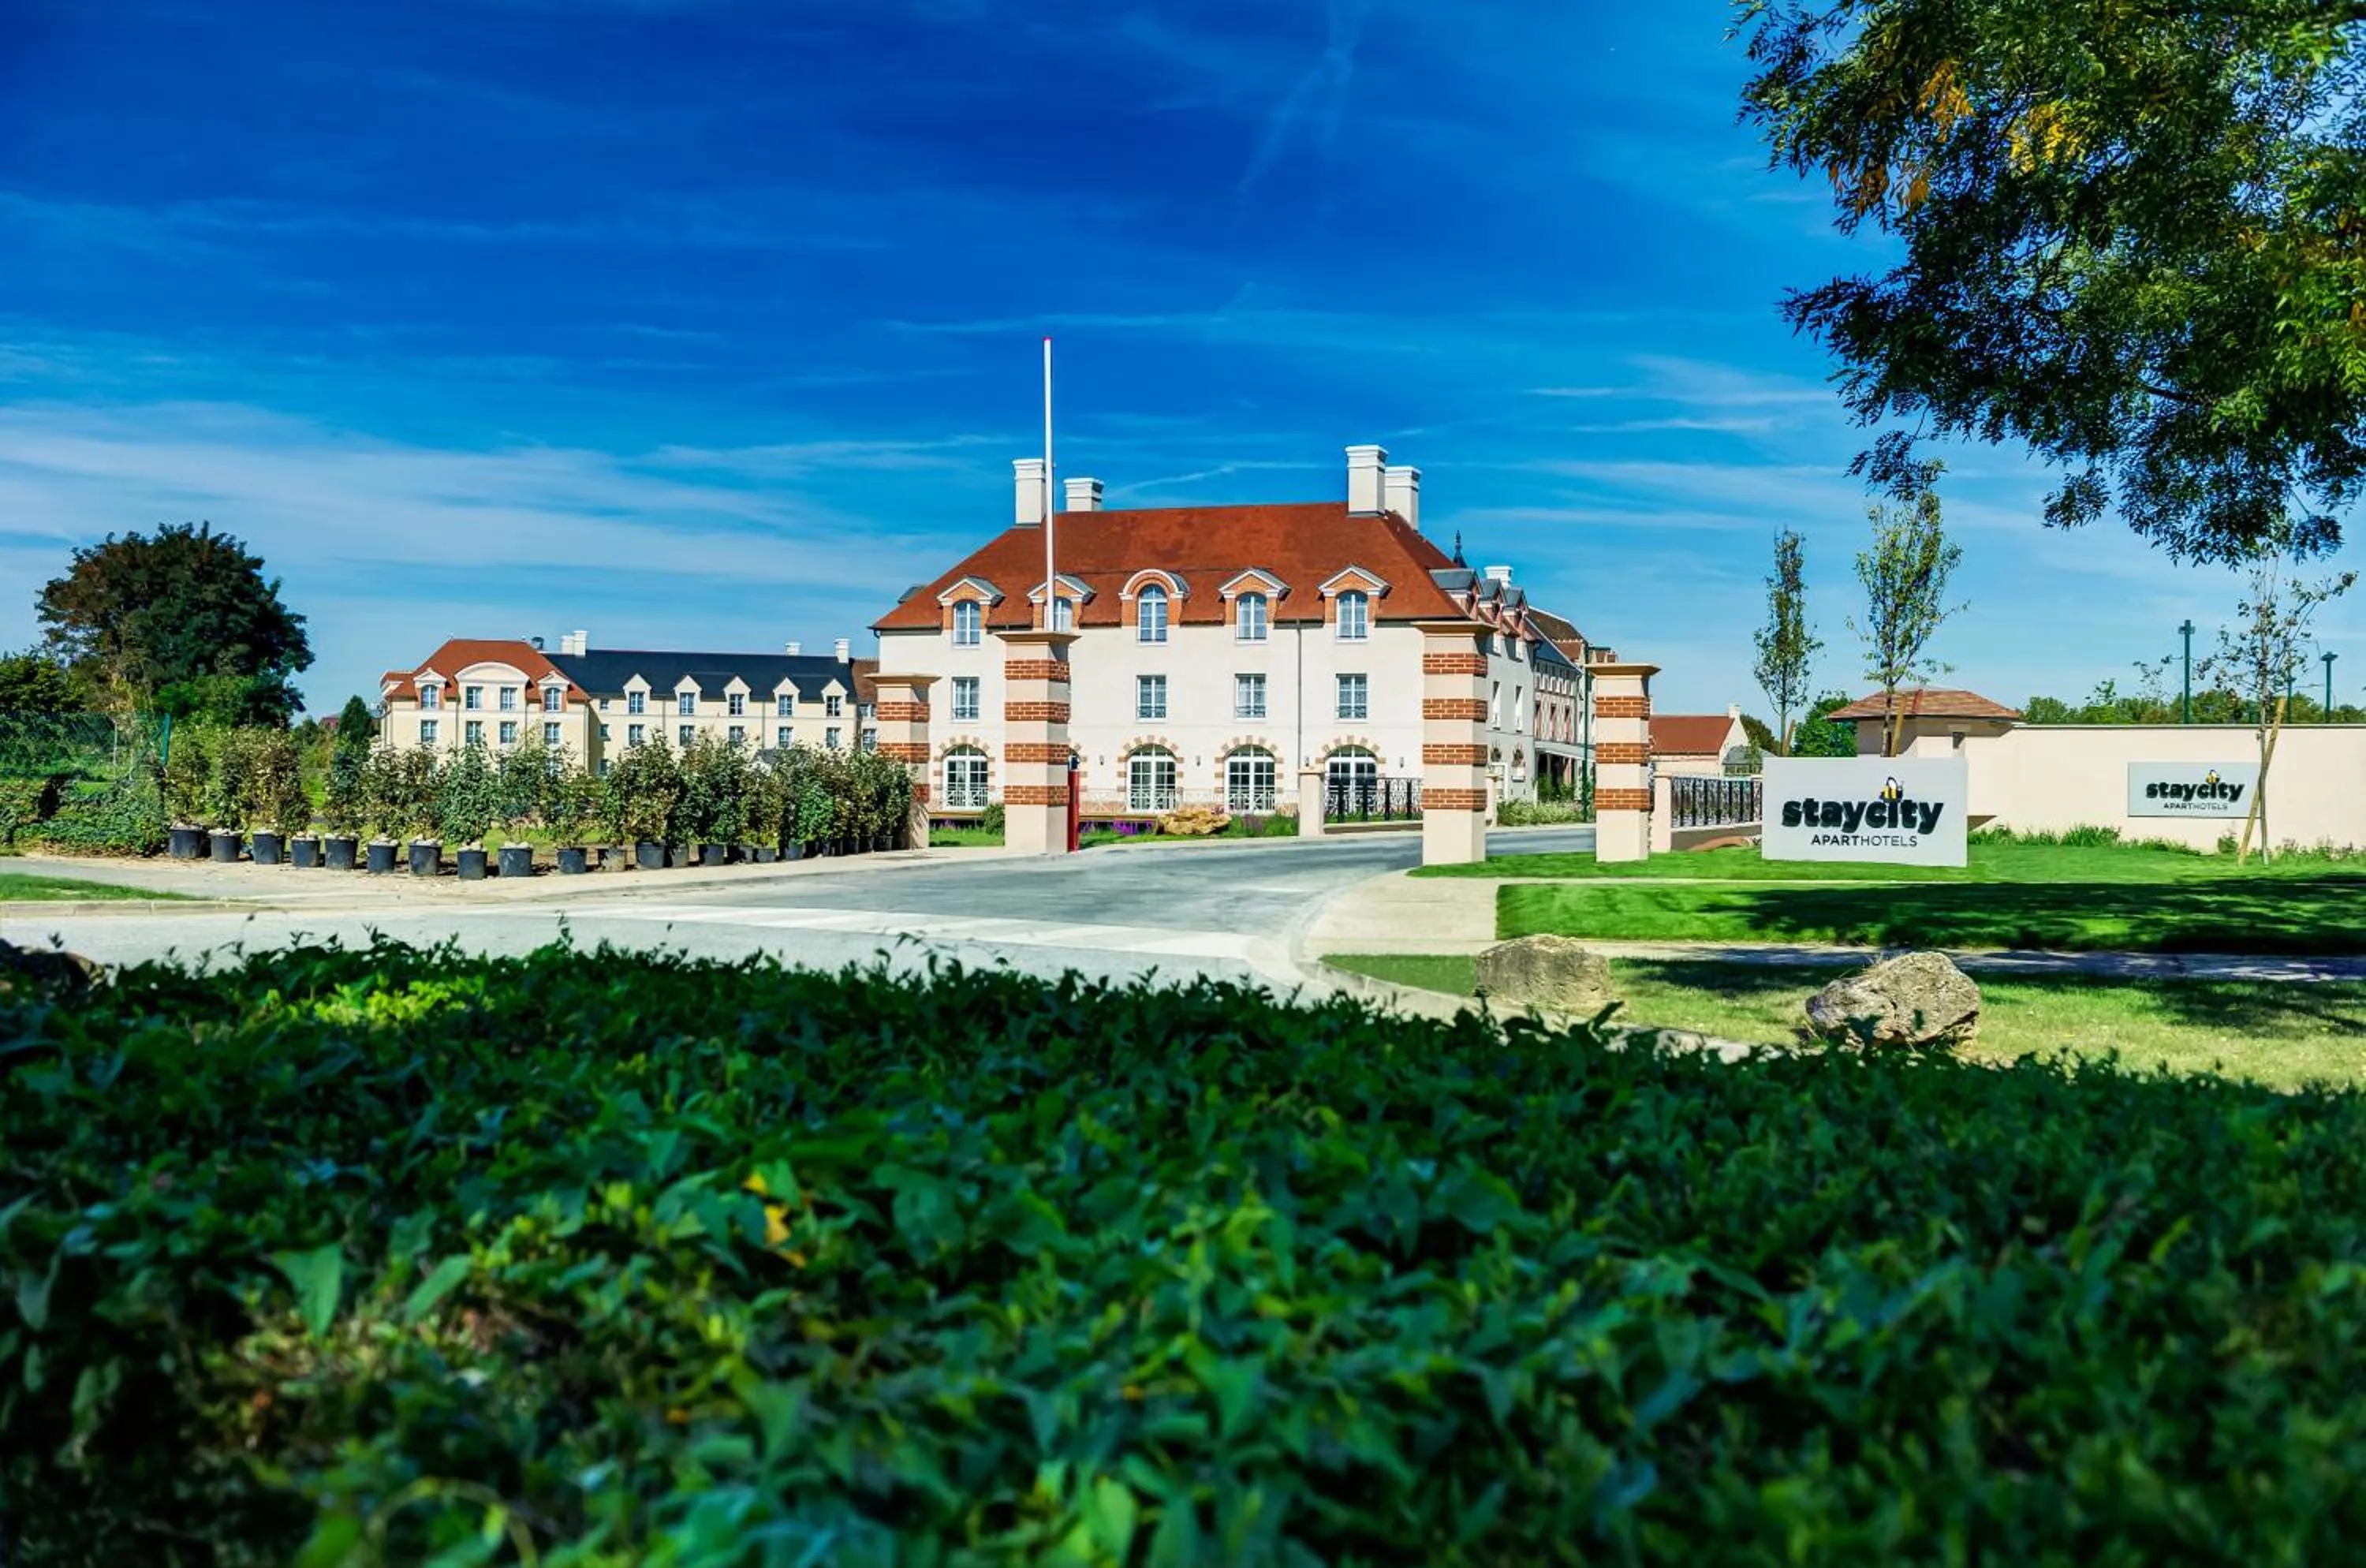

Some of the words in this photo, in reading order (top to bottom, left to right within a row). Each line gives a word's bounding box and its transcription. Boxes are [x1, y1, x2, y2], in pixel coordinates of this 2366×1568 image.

[2145, 782, 2245, 802] staycity
[1781, 797, 1944, 834] staycity
[1811, 834, 1917, 847] APARTHOTELS
